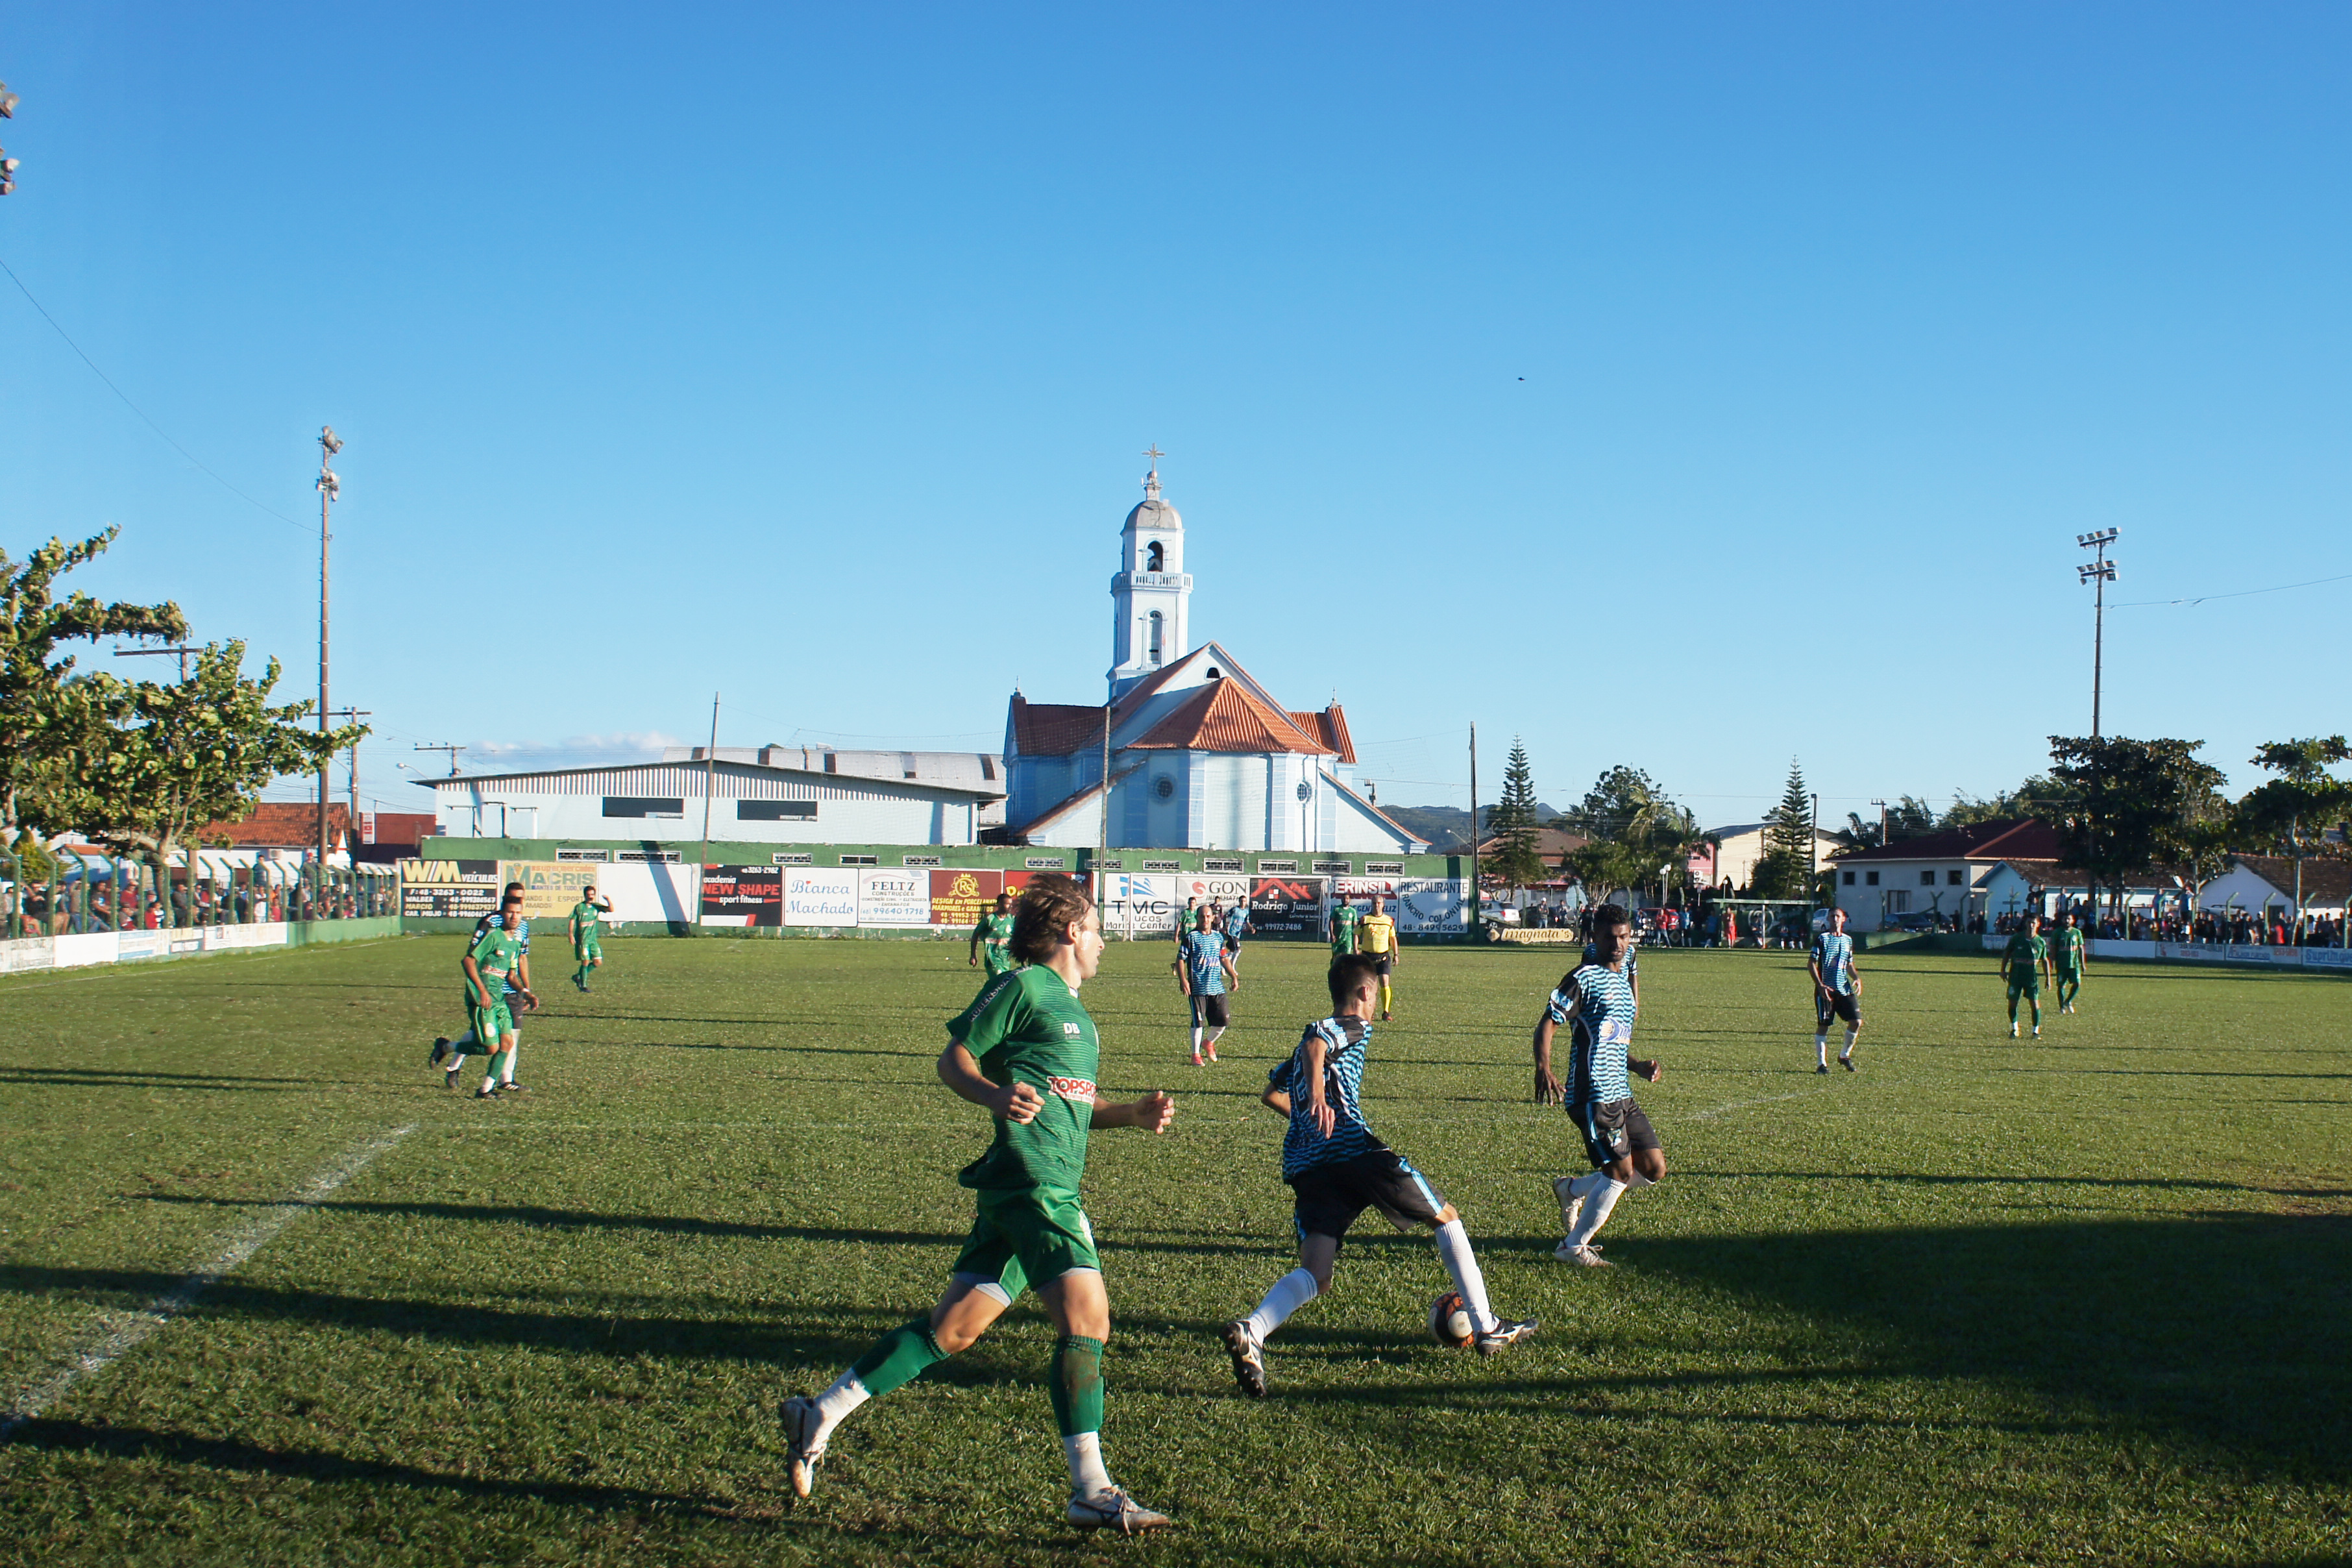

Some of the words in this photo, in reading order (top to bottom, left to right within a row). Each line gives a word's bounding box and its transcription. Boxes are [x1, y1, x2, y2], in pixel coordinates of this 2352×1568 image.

[703, 875, 737, 883] academia
[703, 883, 735, 894] NEW
[737, 884, 780, 895] SHAPE
[790, 879, 851, 894] Bianca
[1401, 882, 1468, 894] RESTAURANTE
[719, 896, 739, 906] sport
[740, 894, 763, 903] fitness
[786, 900, 854, 914] Machado
[1111, 901, 1168, 914] TMC
[1251, 901, 1288, 913] Rodrigo
[1291, 901, 1319, 913] Junior
[1402, 894, 1424, 920] RANCHO
[1428, 897, 1465, 922] COLONIAL
[1063, 1022, 1080, 1034] DB
